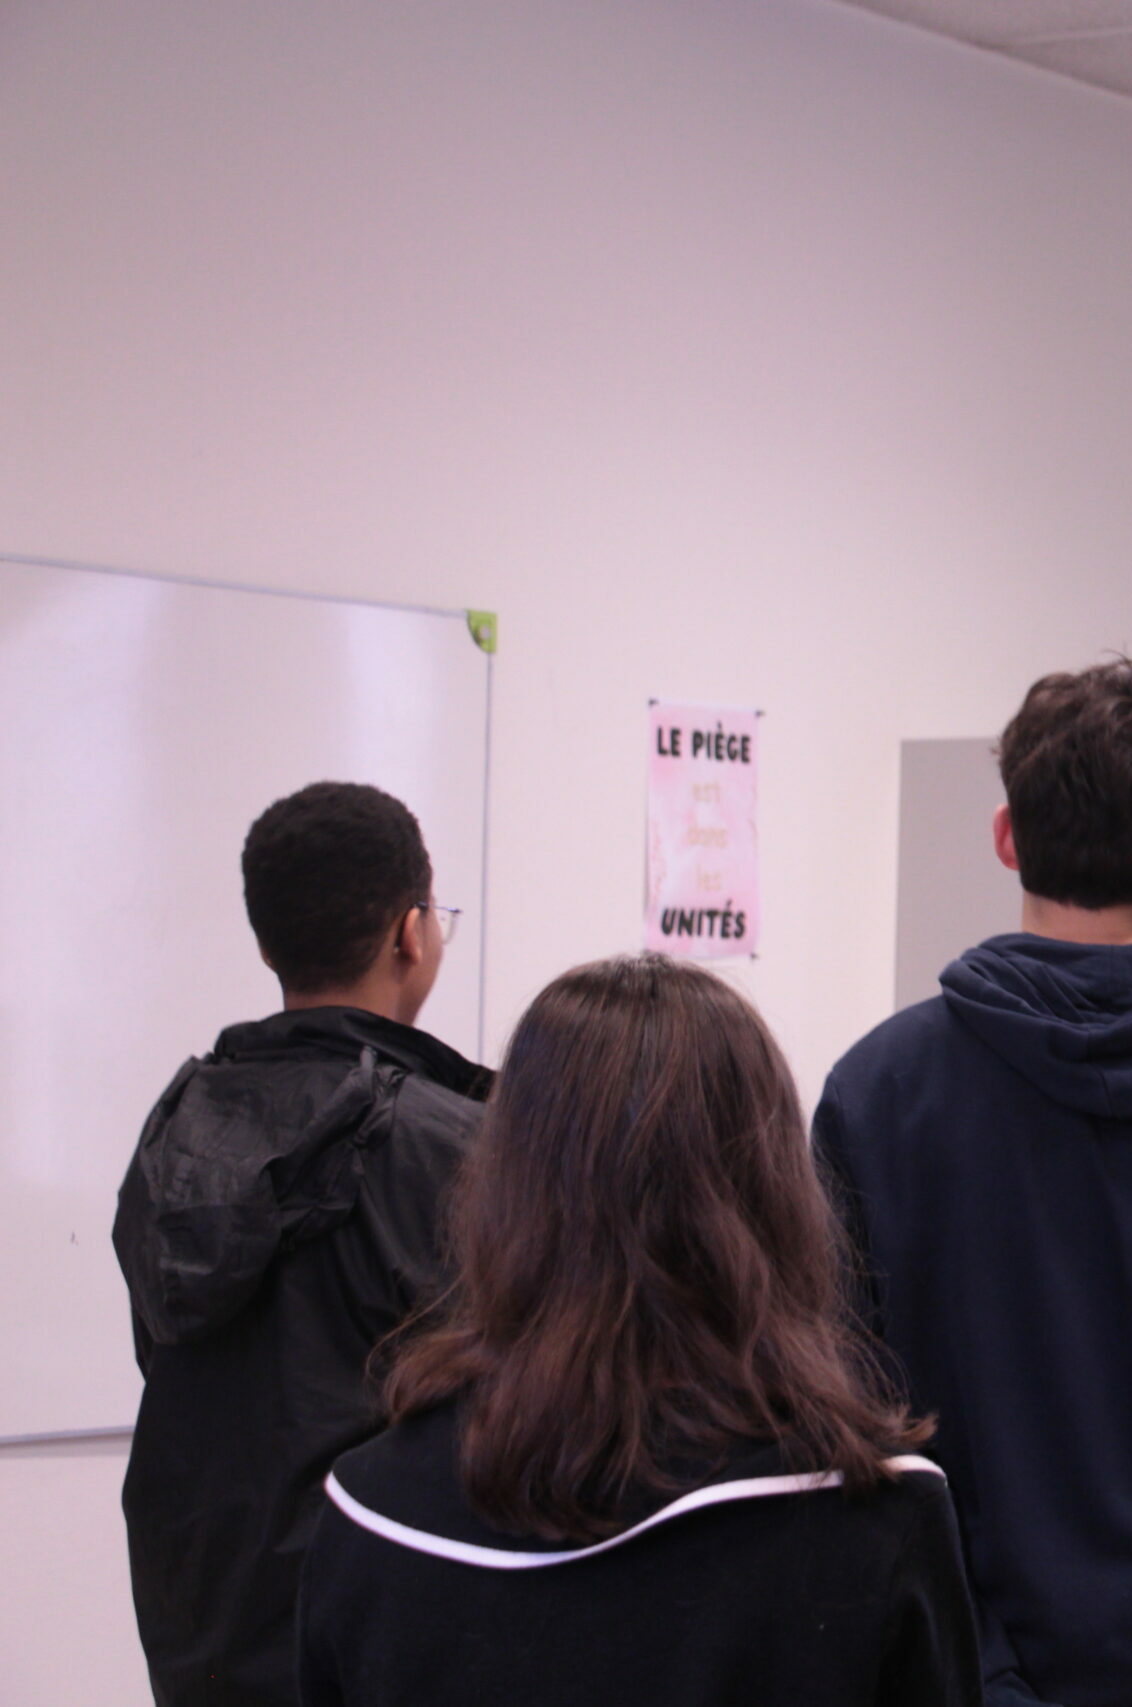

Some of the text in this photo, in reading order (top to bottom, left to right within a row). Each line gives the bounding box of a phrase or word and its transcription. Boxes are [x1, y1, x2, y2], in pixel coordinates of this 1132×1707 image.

[656, 720, 751, 763] LE PIÈGE
[660, 899, 746, 939] UNITÉS
